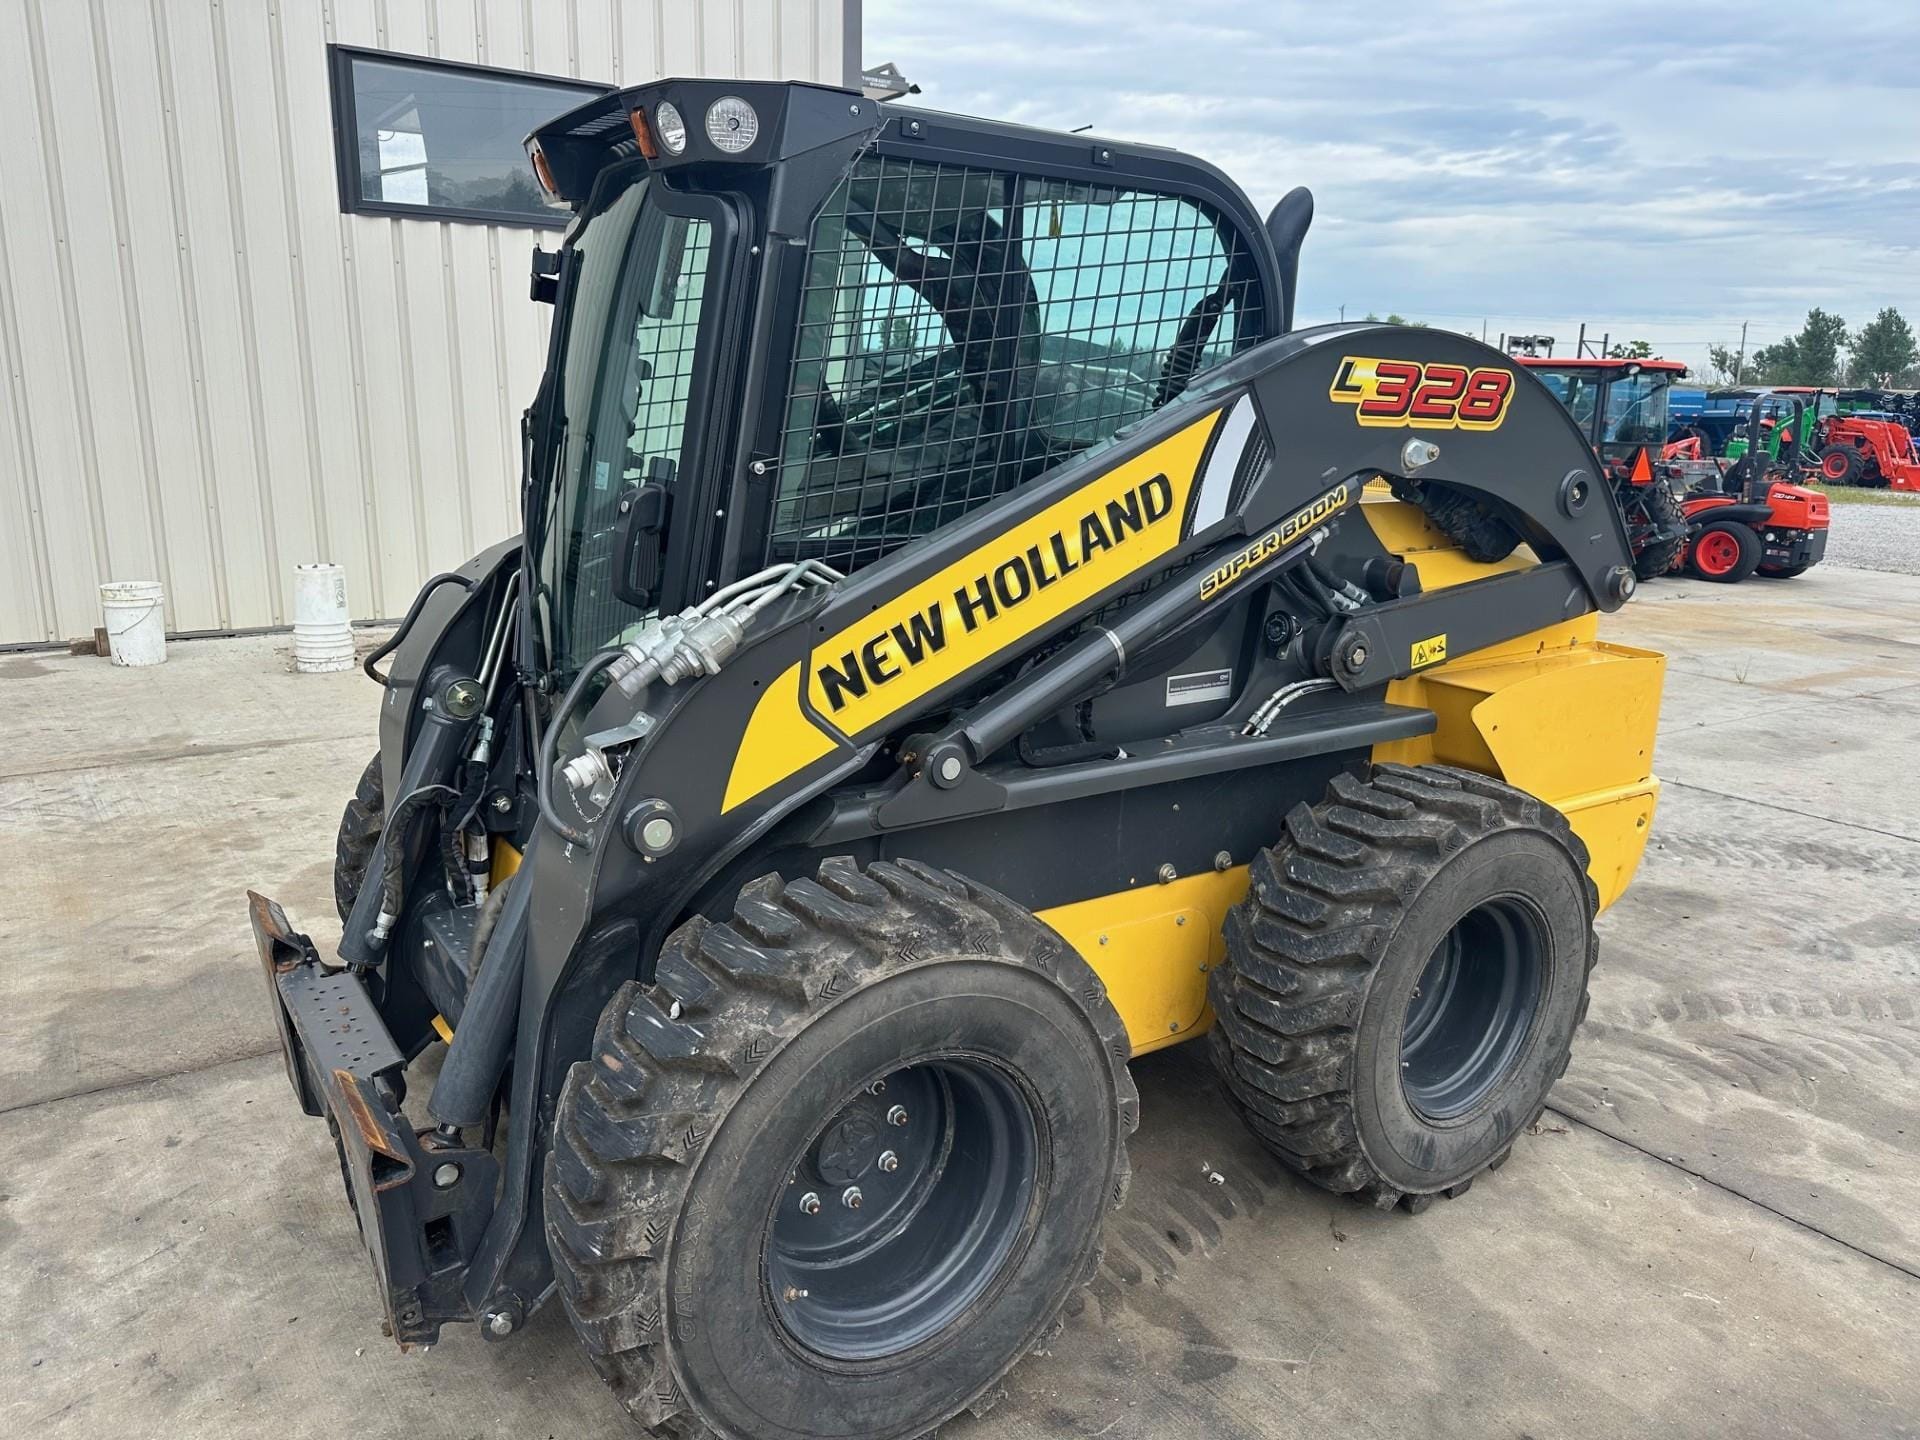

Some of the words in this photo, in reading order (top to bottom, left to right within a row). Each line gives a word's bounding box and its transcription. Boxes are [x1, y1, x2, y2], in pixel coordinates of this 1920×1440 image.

[1331, 357, 1514, 429] L328
[816, 600, 948, 713] NEW
[953, 472, 1174, 633] HOLLAND
[1200, 532, 1280, 600] SUPER
[1281, 484, 1347, 545] BOOM
[675, 1193, 708, 1344] GALAXY
